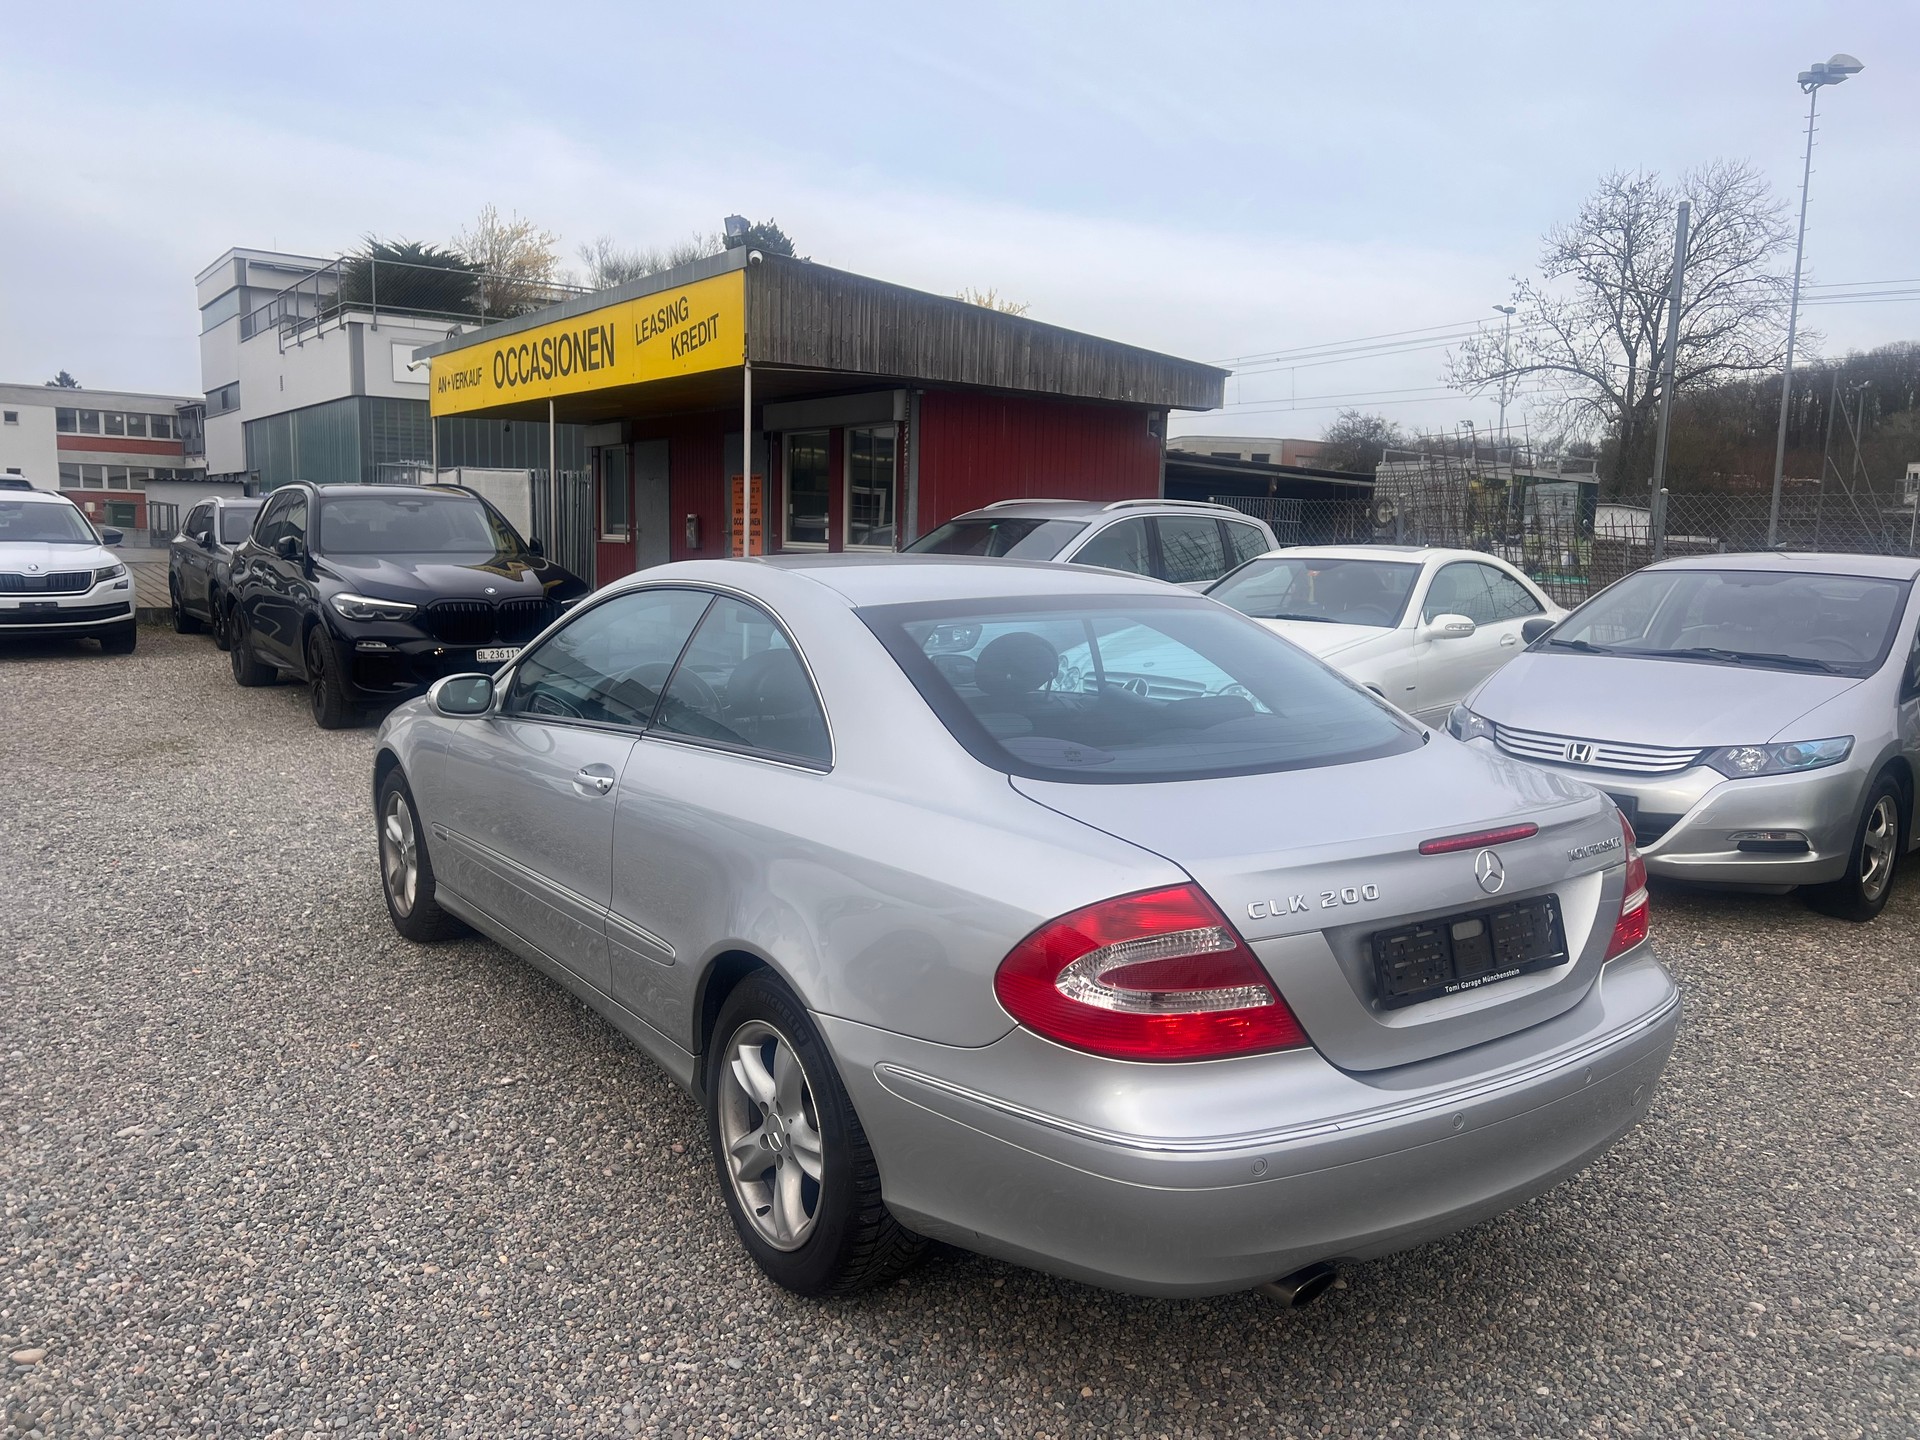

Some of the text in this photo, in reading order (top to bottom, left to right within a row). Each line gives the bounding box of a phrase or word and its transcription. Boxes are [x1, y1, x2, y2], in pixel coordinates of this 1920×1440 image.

[635, 296, 689, 346] LEASING
[671, 313, 719, 360] KREDIT
[493, 323, 615, 389] OCCASIONEN
[1247, 883, 1380, 920] CLK 200
[1460, 979, 1482, 989] Garage
[1482, 968, 1521, 984] Münchenstein
